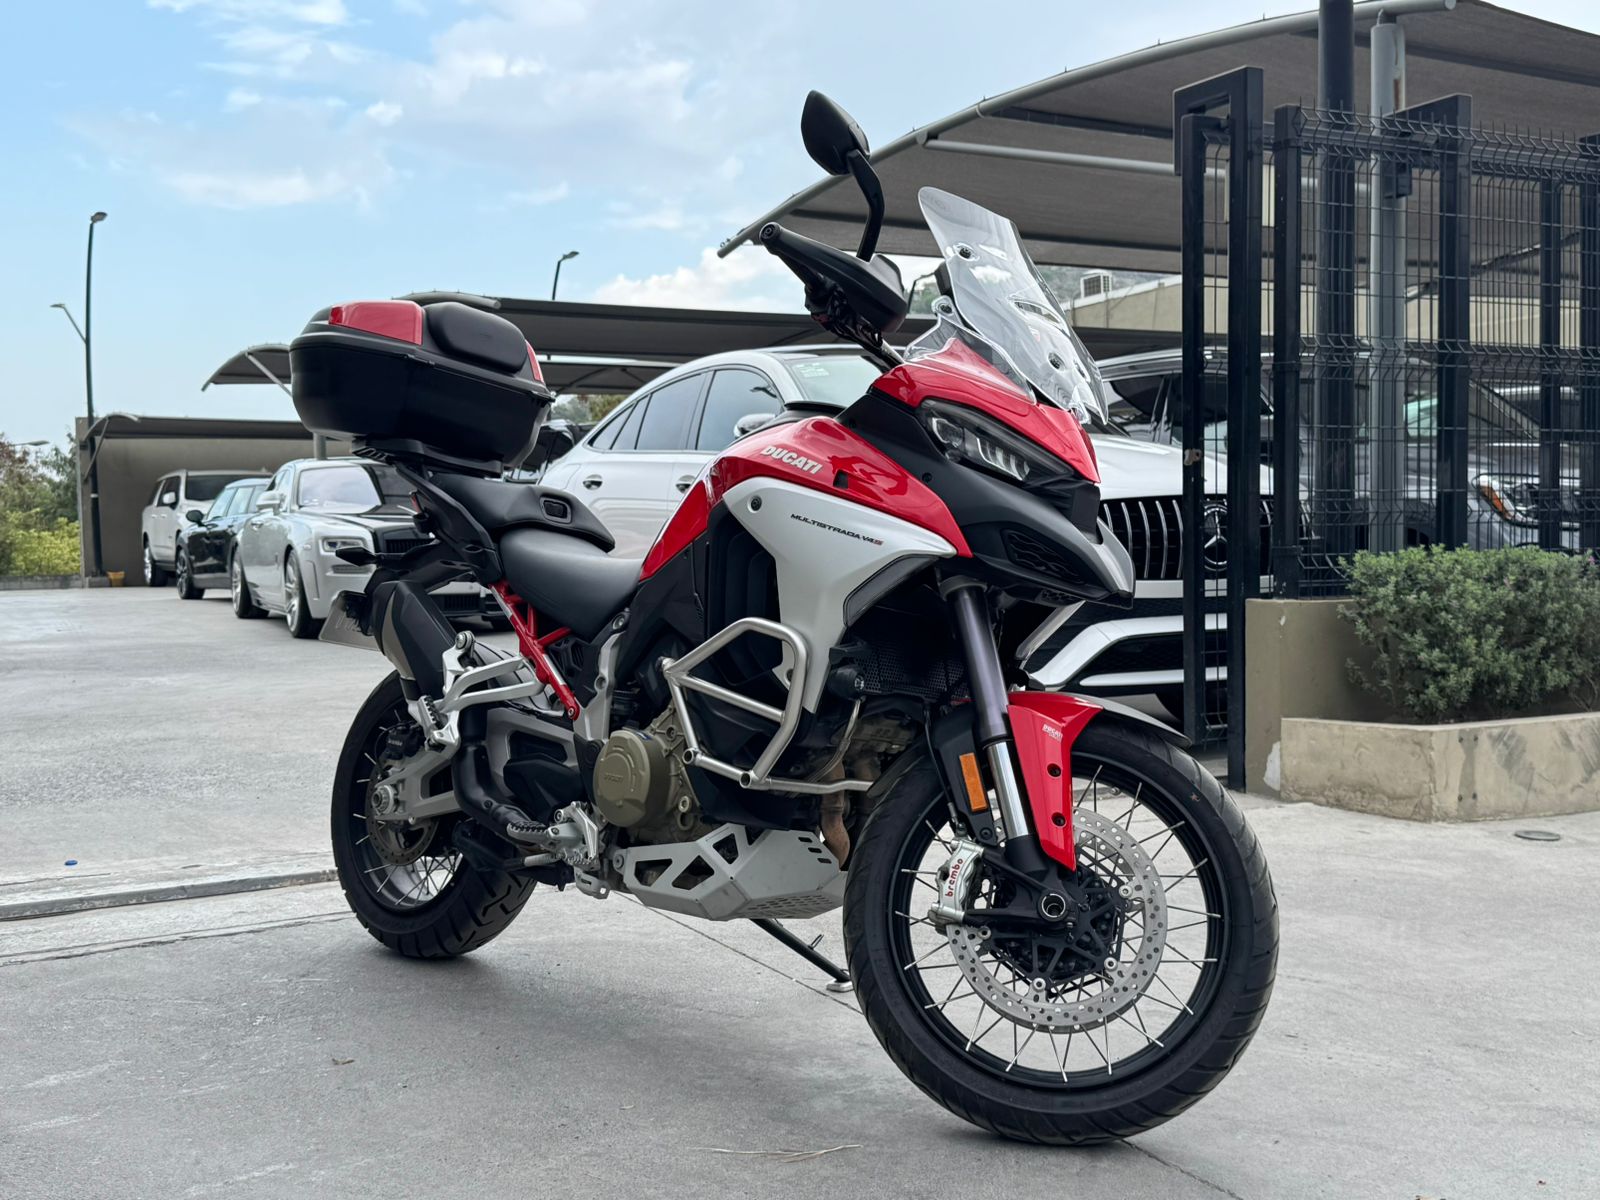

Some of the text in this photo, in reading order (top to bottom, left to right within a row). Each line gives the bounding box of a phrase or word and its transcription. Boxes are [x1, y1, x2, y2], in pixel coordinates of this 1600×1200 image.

[760, 446, 823, 474] DUCATI
[790, 513, 861, 540] MULTISTRADA
[945, 858, 964, 898] brembo
